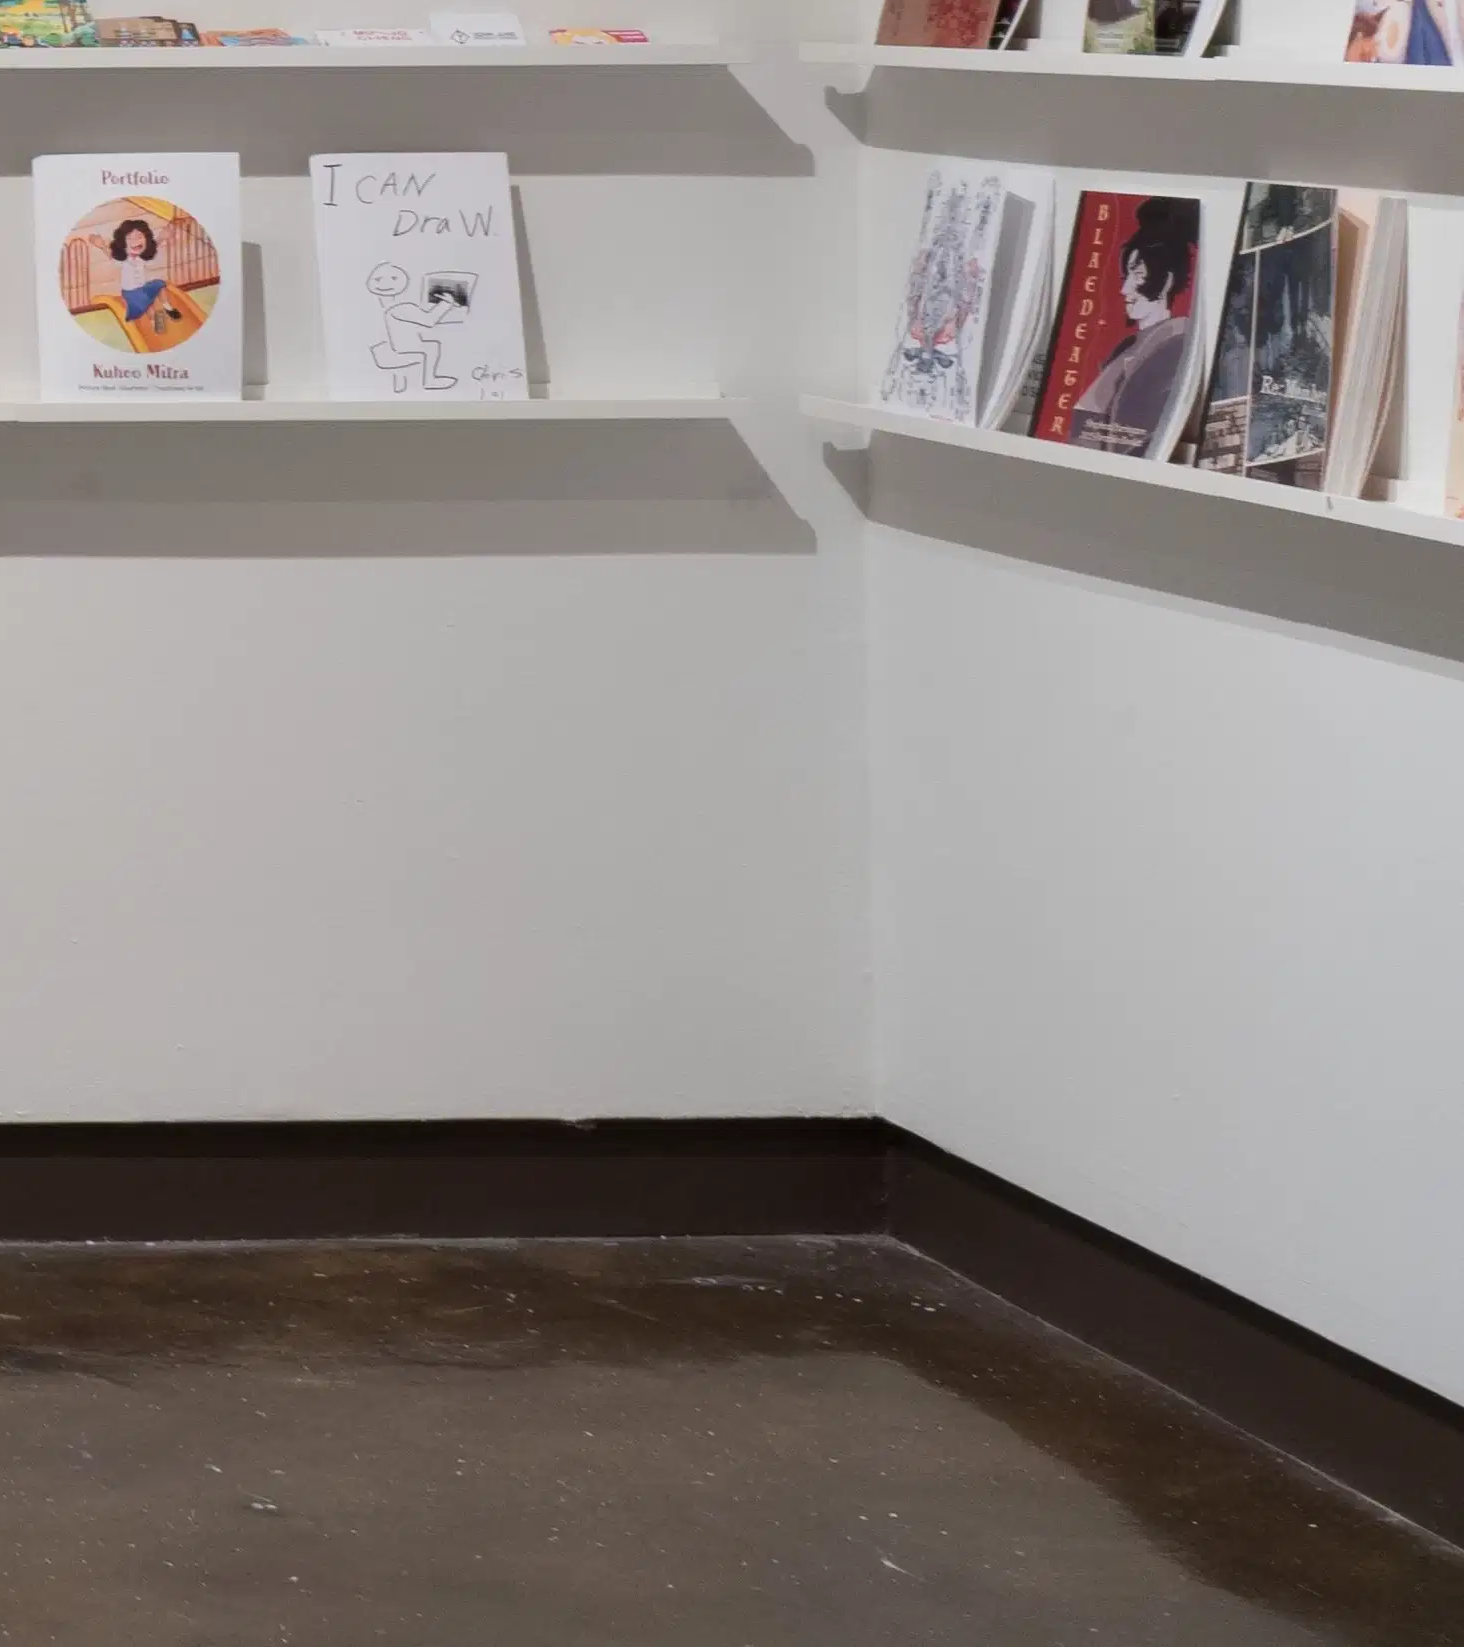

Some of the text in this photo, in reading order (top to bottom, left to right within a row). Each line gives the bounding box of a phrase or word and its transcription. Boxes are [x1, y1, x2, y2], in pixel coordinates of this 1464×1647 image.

[101, 168, 171, 186] Portfolio
[323, 164, 436, 206] I CAN
[147, 363, 189, 379] Mitra
